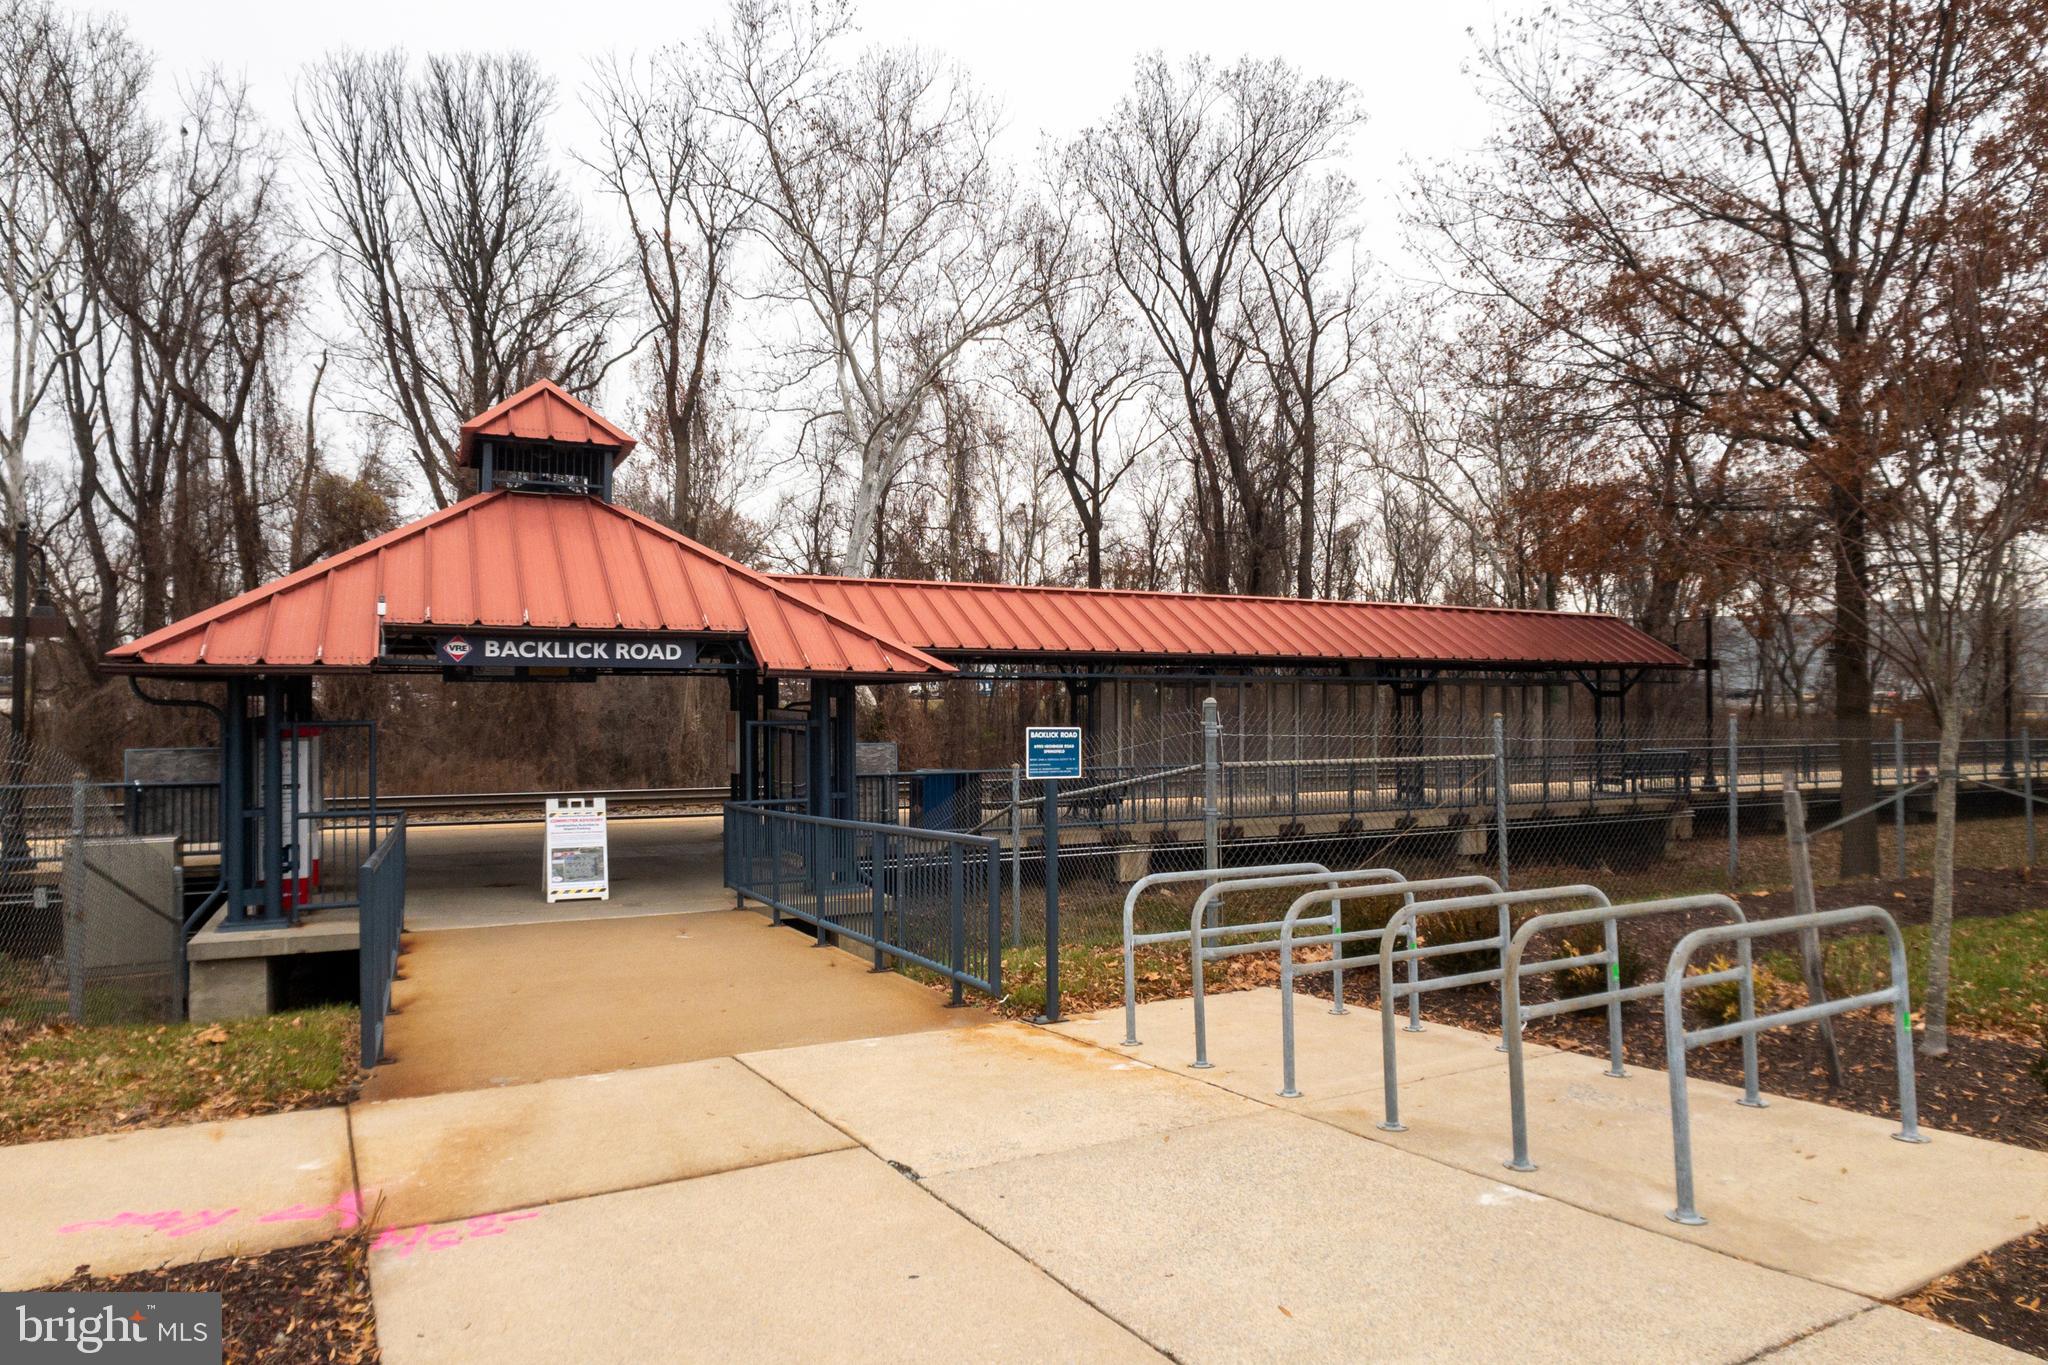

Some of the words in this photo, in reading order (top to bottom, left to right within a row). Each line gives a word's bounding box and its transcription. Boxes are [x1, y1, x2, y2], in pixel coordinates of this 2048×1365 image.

[448, 644, 468, 652] VRE
[485, 640, 608, 659] BACKLICK
[615, 643, 681, 661] ROAD
